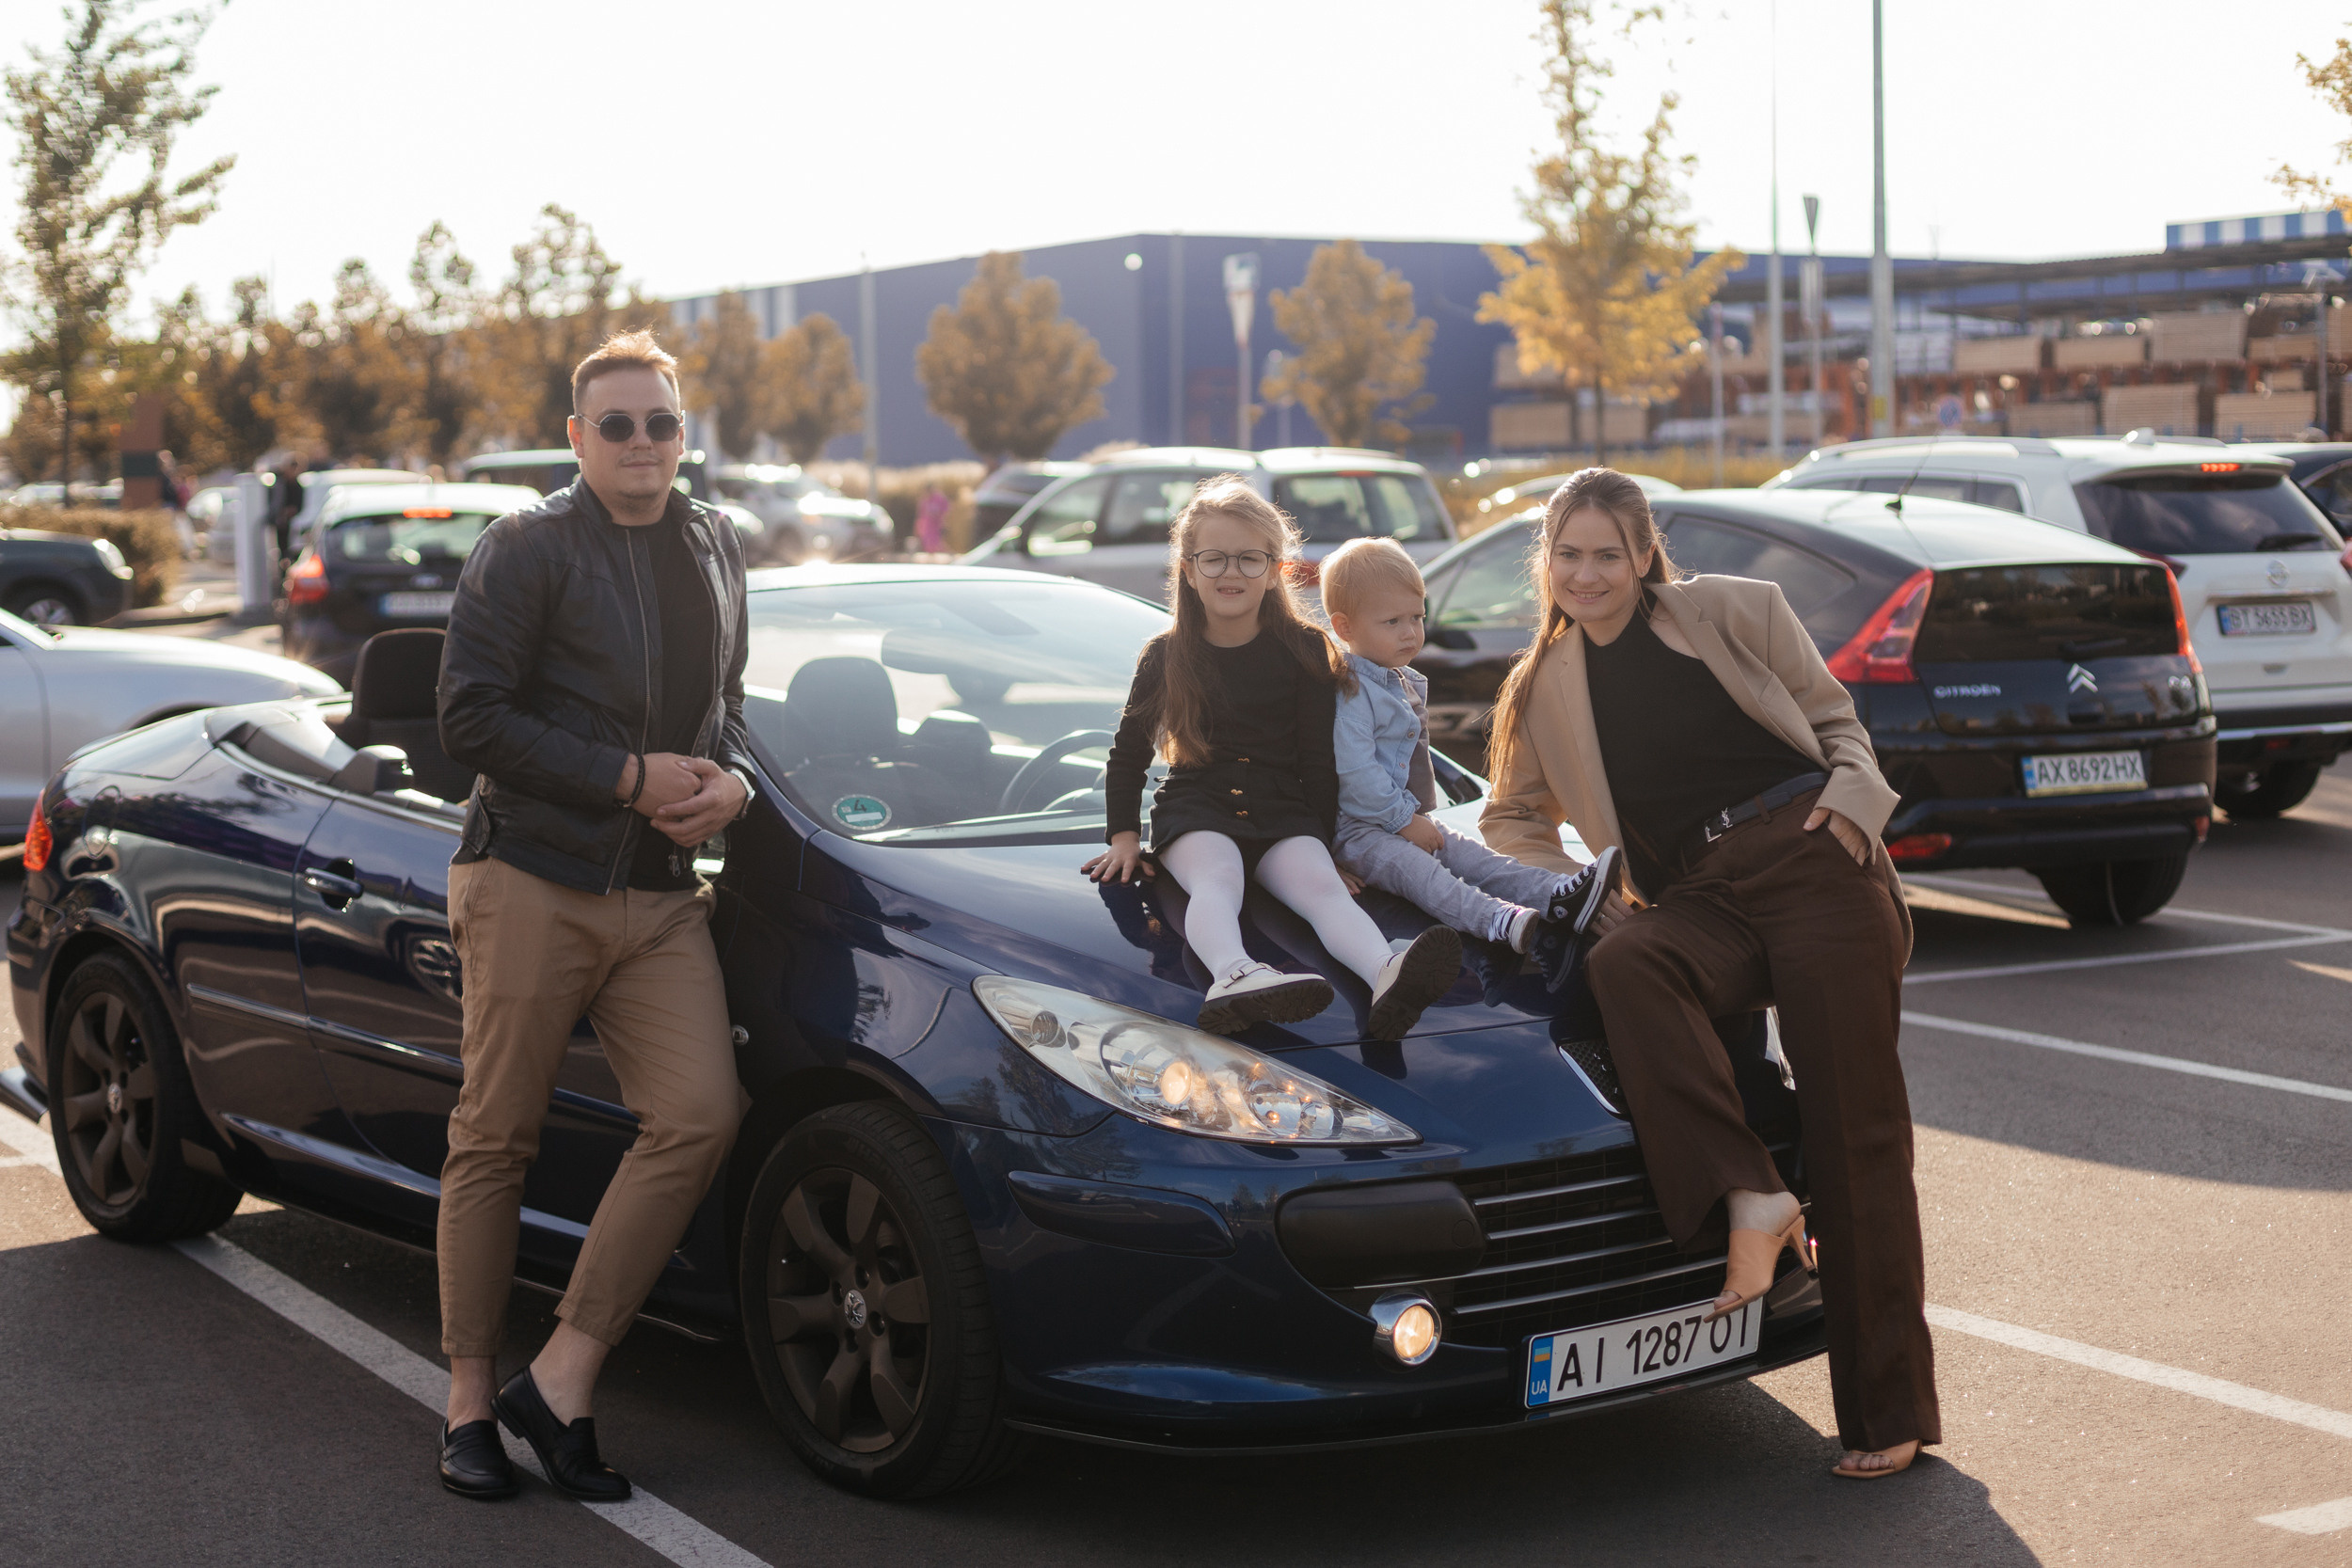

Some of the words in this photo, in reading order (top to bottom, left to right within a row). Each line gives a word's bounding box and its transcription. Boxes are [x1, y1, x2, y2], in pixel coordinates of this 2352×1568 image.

[2229, 608, 2249, 629] BT
[2038, 758, 2066, 784] AX
[2068, 756, 2113, 782] 8692
[2113, 754, 2141, 781] HX
[853, 800, 867, 813] 4
[1557, 1338, 1605, 1391] AI
[1626, 1314, 1702, 1375] 1287
[1531, 1379, 1549, 1396] UA
